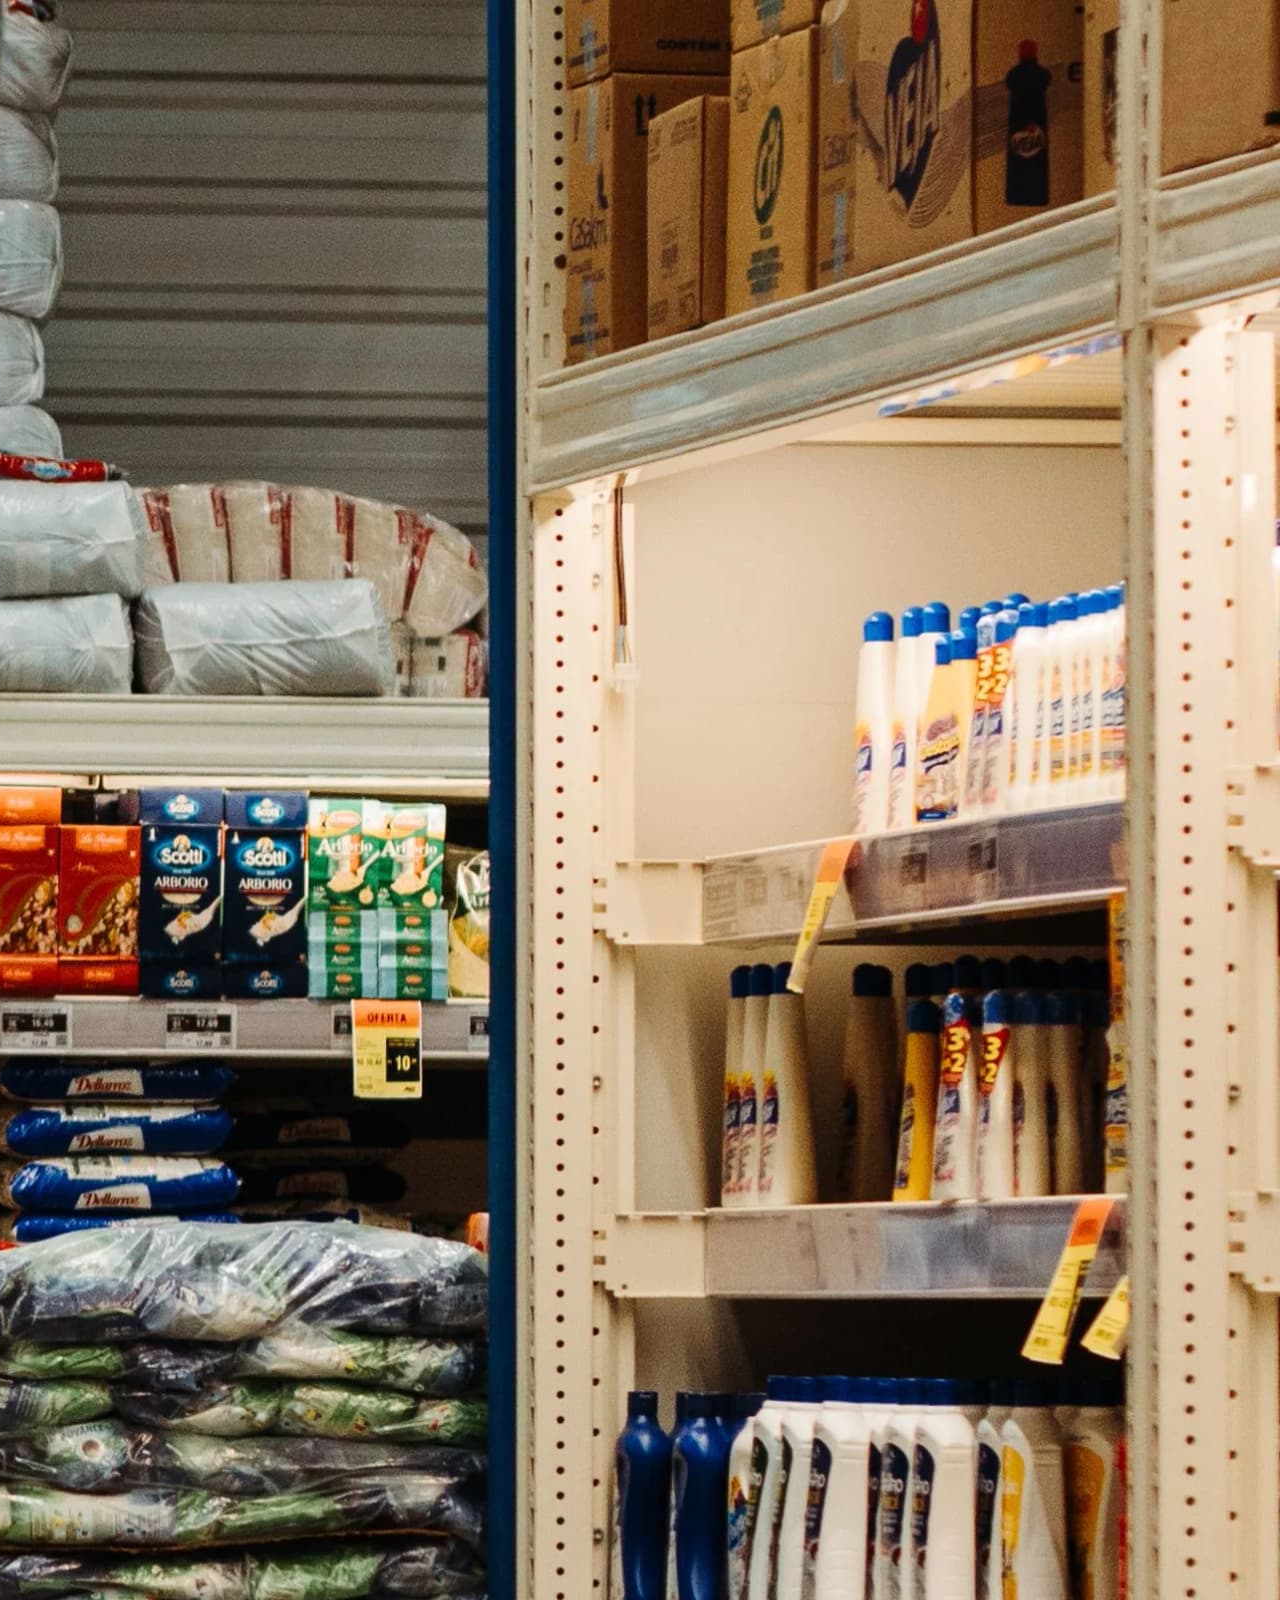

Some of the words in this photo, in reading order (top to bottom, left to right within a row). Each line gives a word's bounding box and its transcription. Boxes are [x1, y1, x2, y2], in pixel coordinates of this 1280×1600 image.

[316, 839, 374, 856] Arborio
[381, 839, 438, 857] Arborio
[160, 848, 203, 865] Scotti
[244, 850, 287, 867] Scotti
[154, 876, 209, 889] ARBORIO
[239, 878, 293, 891] ARBORIO
[367, 1013, 407, 1023] OFERTA
